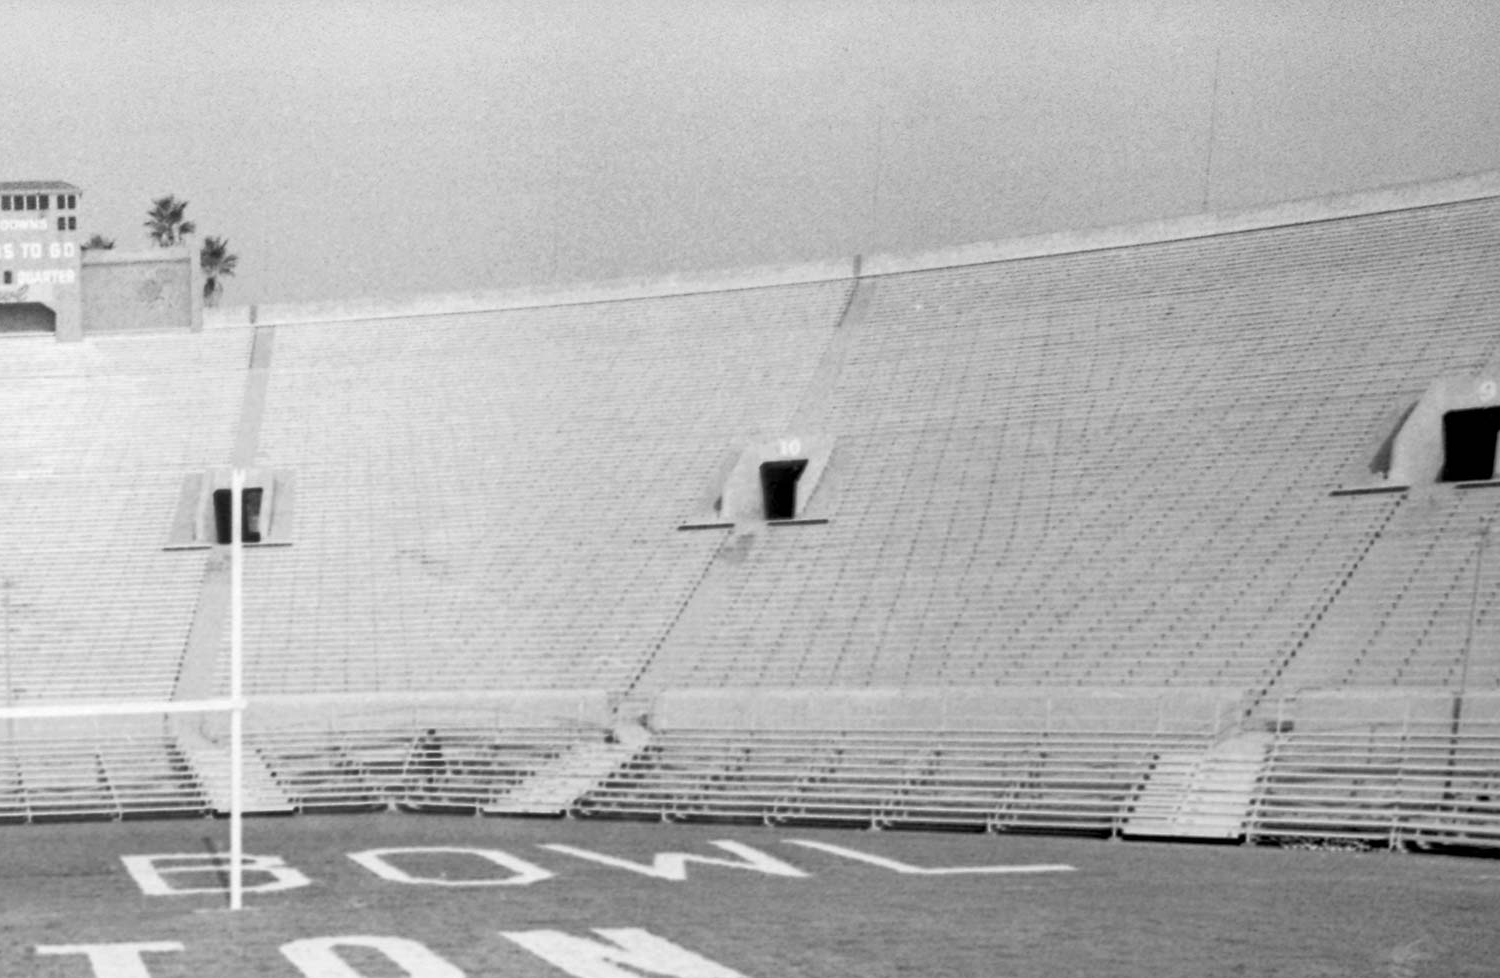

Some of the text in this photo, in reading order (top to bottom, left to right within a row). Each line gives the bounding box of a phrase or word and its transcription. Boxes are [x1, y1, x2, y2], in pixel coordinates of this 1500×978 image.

[0, 219, 48, 231] DOWNS
[21, 242, 42, 259] TO
[49, 241, 76, 259] GO
[17, 268, 76, 285] QUARTER
[779, 437, 801, 457] 10
[119, 839, 1079, 896] BOWL
